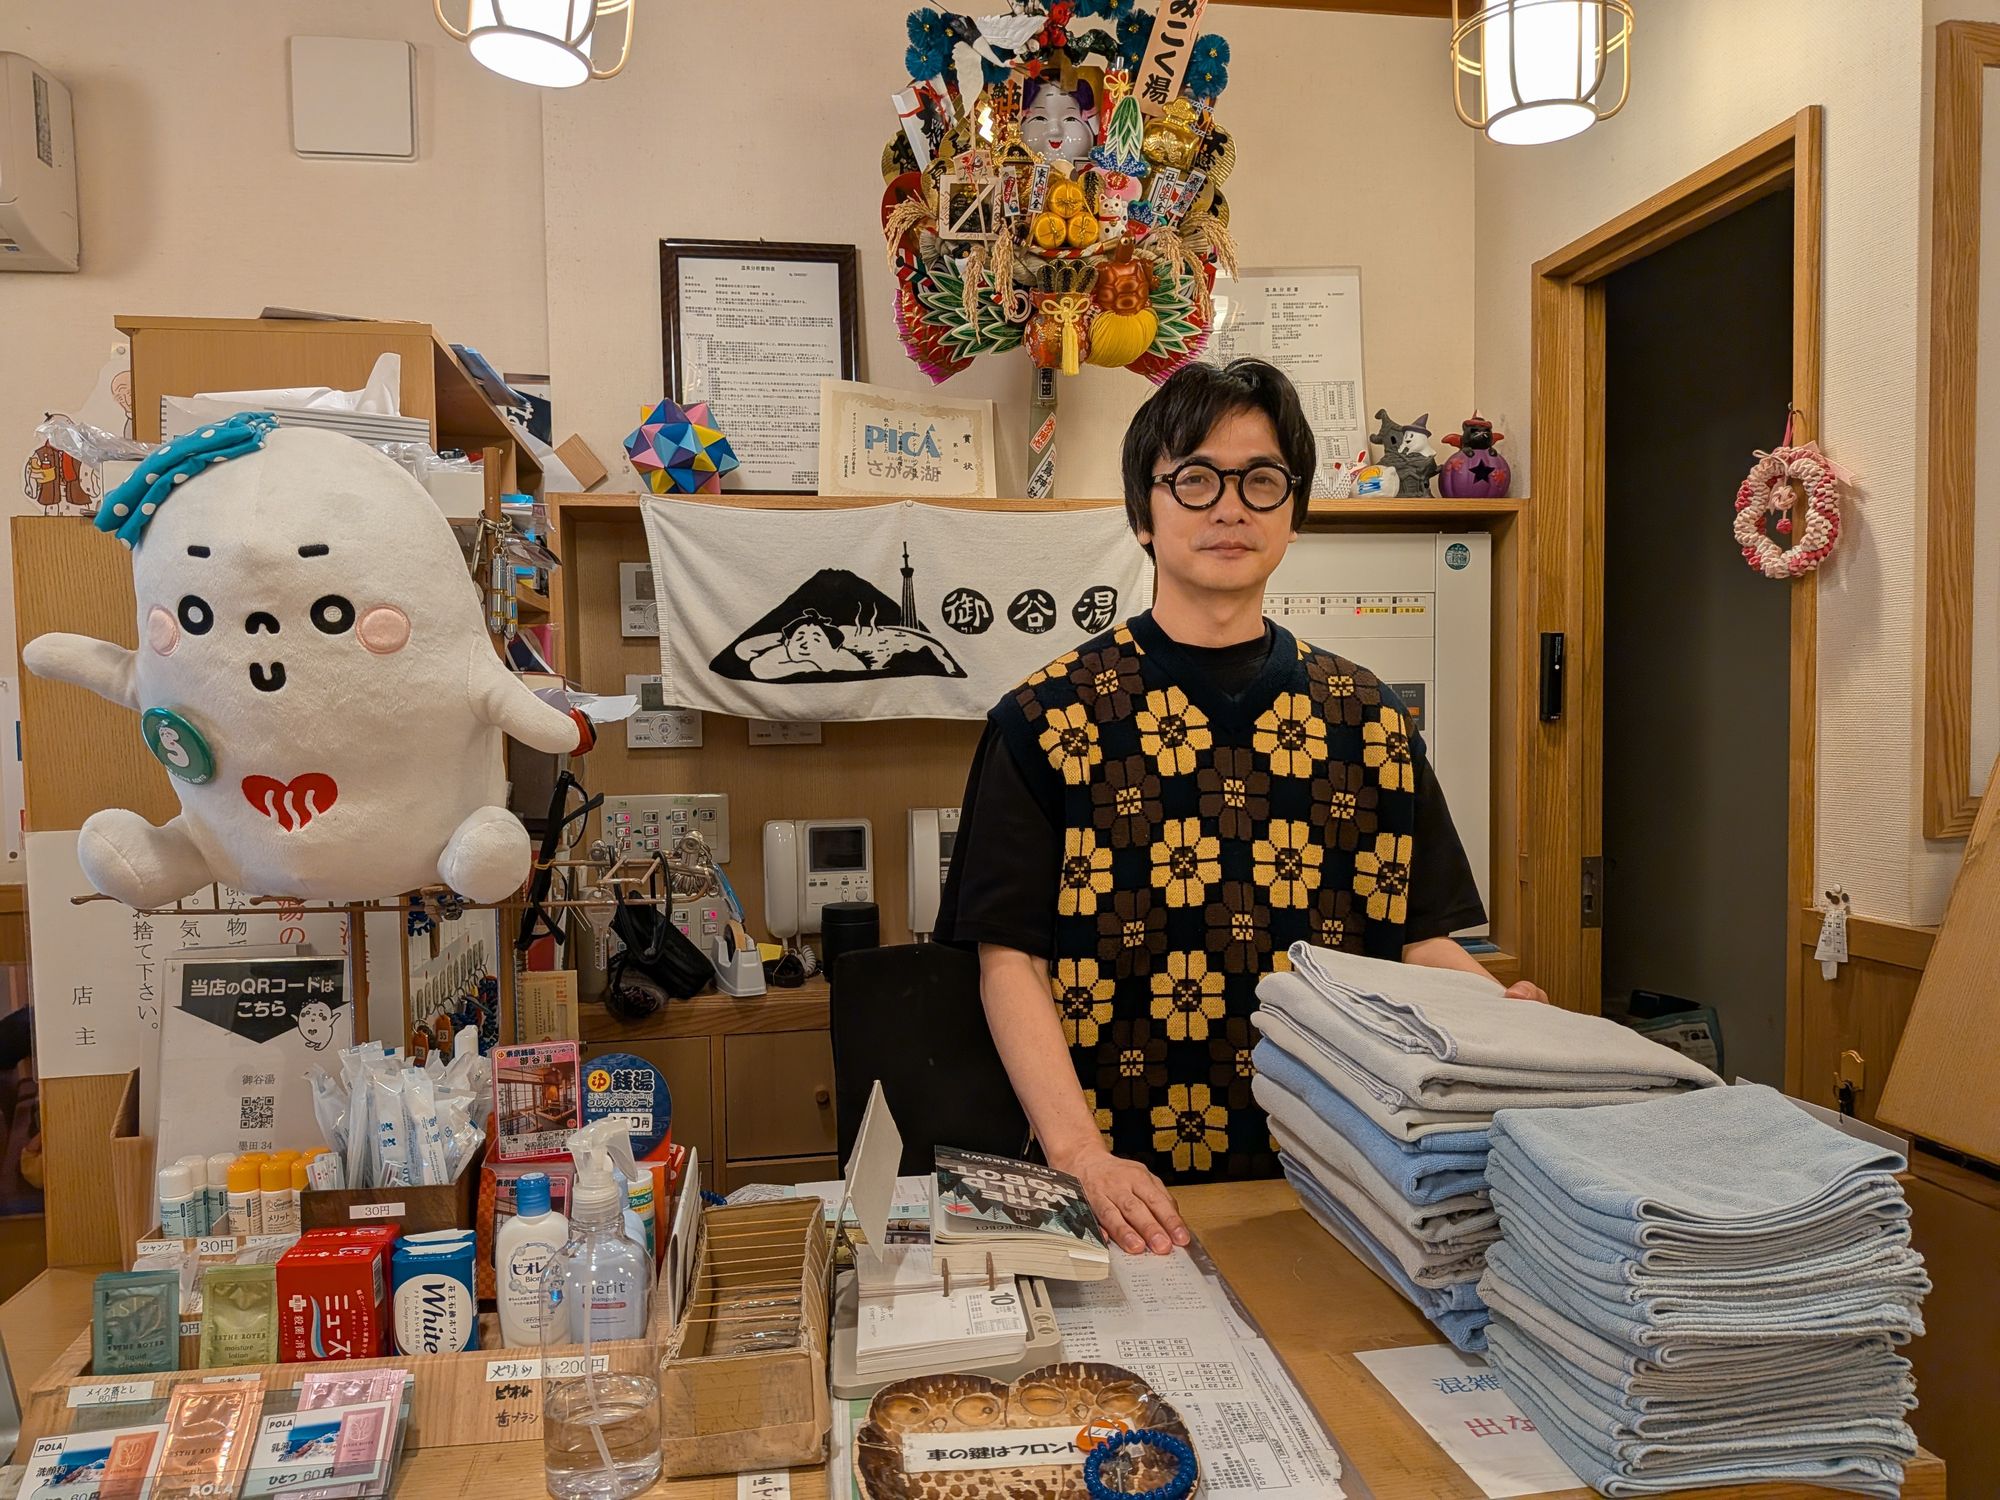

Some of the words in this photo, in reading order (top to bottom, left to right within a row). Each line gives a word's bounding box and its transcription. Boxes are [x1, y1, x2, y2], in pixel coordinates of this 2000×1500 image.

[865, 423, 941, 458] PICA
[867, 460, 941, 482] さがみ湖
[190, 977, 335, 997] 当店のQRコードは
[236, 1000, 287, 1018] こちら
[241, 1074, 275, 1085] 御谷湯
[611, 1069, 655, 1092] 銭湯
[948, 1165, 1079, 1200] ROBOT
[961, 1177, 1071, 1207] WILD
[365, 1205, 390, 1216] 30円
[981, 1190, 1058, 1213] THE
[141, 1243, 180, 1252] シャンプー
[200, 1240, 234, 1253] 30円
[325, 1294, 351, 1359] ミューズ
[422, 1282, 447, 1354] White
[179, 1322, 199, 1335] 0円
[86, 1385, 136, 1396] メイク落とし
[269, 1419, 294, 1429] POLA
[495, 1409, 539, 1427] 歯ブラシ
[38, 1442, 62, 1452] POLA
[926, 1441, 1081, 1461] 車の鍵はフロント
[268, 1474, 298, 1486] ひとつ
[752, 1476, 785, 1500] はで
